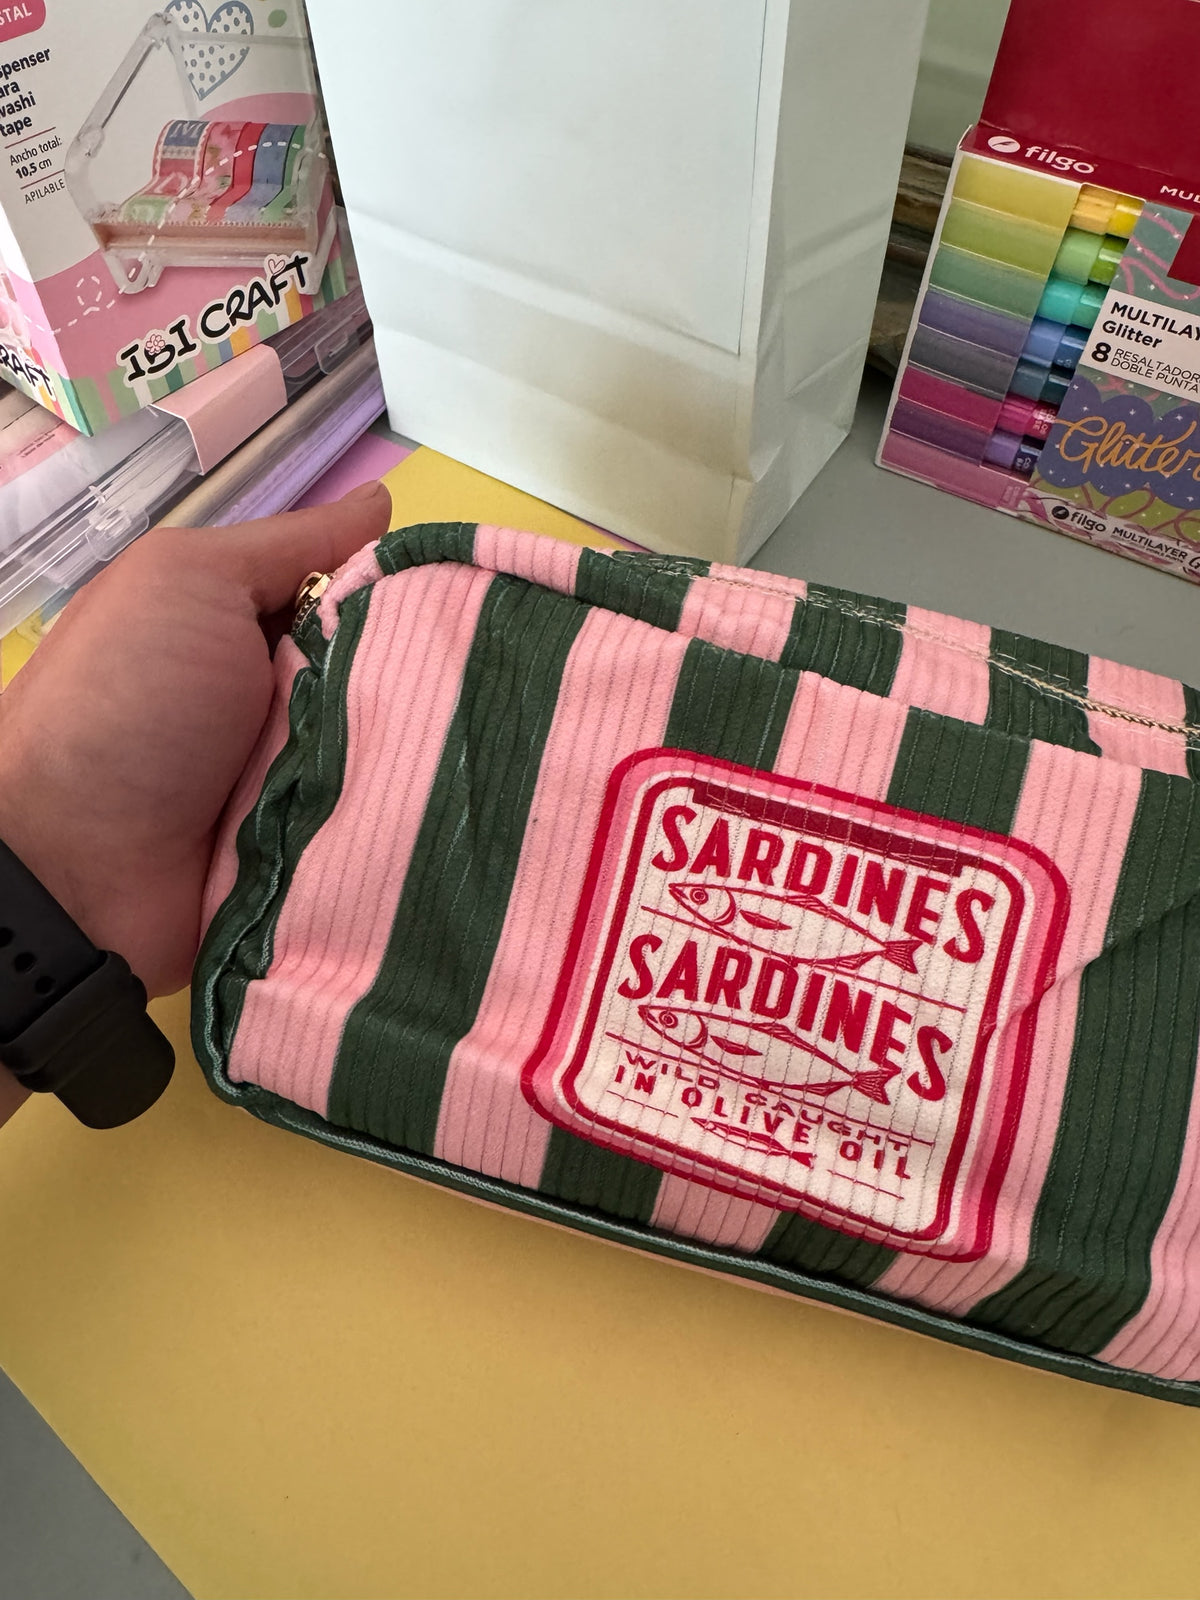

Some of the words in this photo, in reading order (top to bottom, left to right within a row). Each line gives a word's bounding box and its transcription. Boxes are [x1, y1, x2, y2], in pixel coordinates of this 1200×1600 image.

[0, 116, 32, 137] tape
[10, 148, 38, 166] Ancho
[39, 136, 62, 153] total:
[16, 162, 38, 179] 10,5
[38, 158, 52, 170] cm
[1025, 146, 1095, 173] filgo
[25, 178, 66, 204] APILABLE
[121, 319, 197, 381] IBI
[200, 255, 308, 338] CRAFT
[1102, 320, 1163, 349] Glitter
[0, 344, 52, 396] RAFT
[1091, 342, 1112, 363] 8
[1110, 357, 1155, 378] DOBLE
[1155, 372, 1199, 393] PUNTA
[1070, 511, 1106, 532] filgo
[1112, 526, 1188, 559] MULTILAYER
[651, 805, 996, 964] SARDINES
[617, 934, 953, 1101] SARDINES
[625, 1050, 719, 1089] WILD
[614, 1065, 656, 1094] IN
[681, 1086, 812, 1144] OLIVE
[839, 1140, 911, 1180] OIL
